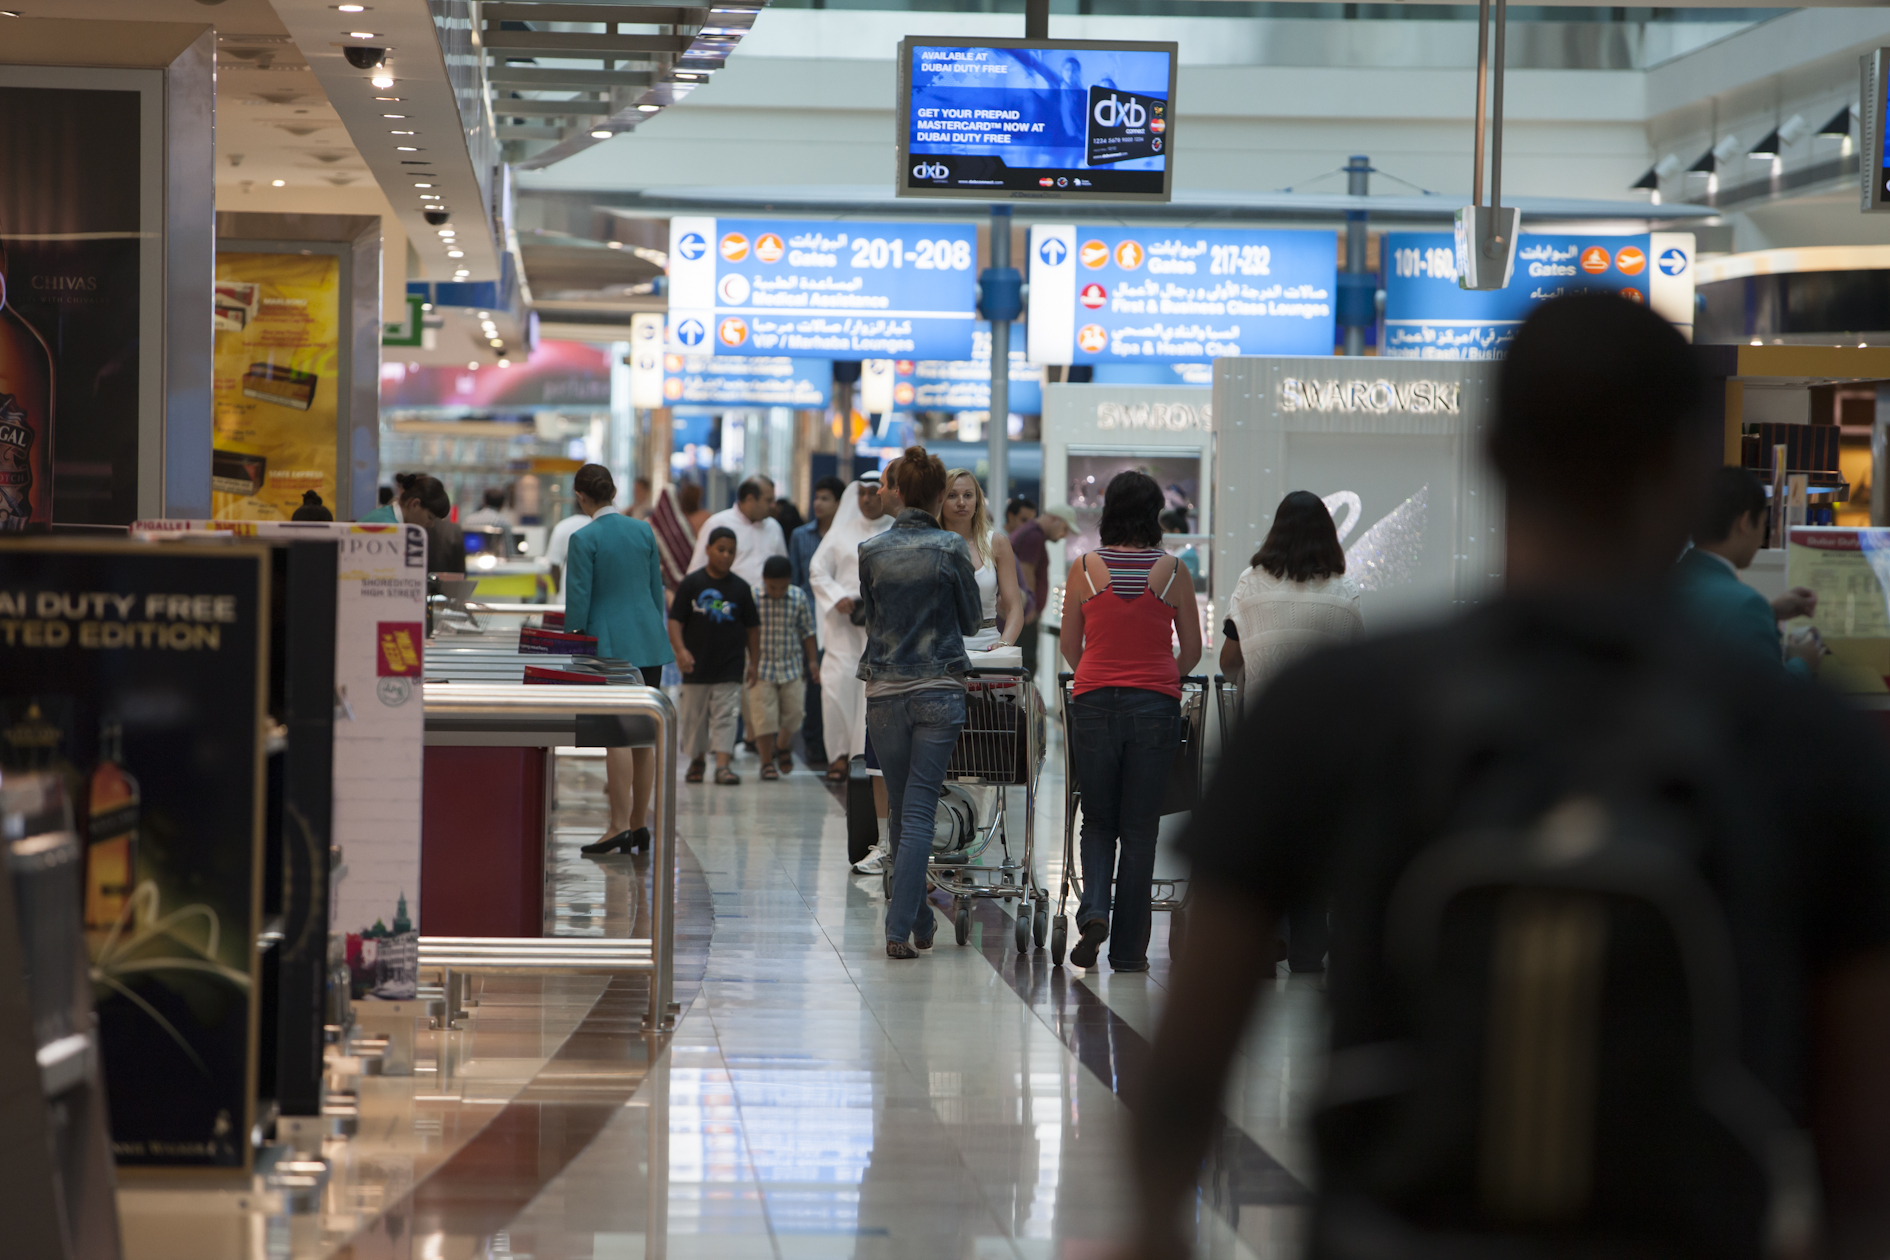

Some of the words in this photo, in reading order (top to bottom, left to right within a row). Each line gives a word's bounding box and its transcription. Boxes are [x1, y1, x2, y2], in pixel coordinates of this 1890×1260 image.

[921, 51, 973, 61] AVAILABLE
[975, 52, 988, 61] AT
[921, 63, 952, 72] DUBAI
[953, 64, 981, 73] DUTY
[982, 64, 1008, 74] FREE
[917, 108, 940, 118] GET
[941, 108, 973, 119] YOUR
[974, 109, 1020, 120] PREPAID
[1093, 93, 1147, 128] dxb
[1003, 122, 1030, 132] NOW
[1031, 122, 1045, 132] AT
[917, 132, 951, 142] DUBAI
[952, 133, 982, 143] DUTY
[983, 134, 1011, 144] FREE
[912, 161, 950, 179] dxb
[788, 249, 837, 268] Gates
[850, 237, 971, 271] 201-208
[1147, 256, 1197, 275] Gates
[1528, 261, 1577, 278] Gates
[31, 275, 98, 290] CHIVAS
[1111, 297, 1145, 314] First
[1159, 298, 1226, 315] Business
[1226, 299, 1267, 316] Class
[1268, 300, 1330, 319] Lounges
[752, 333, 779, 349] VIP
[851, 335, 915, 354] Lounges
[1110, 339, 1141, 357] Spa
[1156, 340, 1204, 356] Health
[1204, 340, 1241, 356] Club
[1280, 377, 1461, 414] SWAROVSKI
[1097, 402, 1213, 431] SWAROVS
[0, 424, 27, 448] GAL
[136, 521, 183, 531] PIGALLE
[361, 578, 421, 587] SHOREDITCH
[360, 588, 384, 597] HIGH
[386, 588, 421, 597] STREET
[36, 591, 136, 621] DUTY
[145, 593, 237, 623] FREE
[78, 620, 222, 652] EDITION
